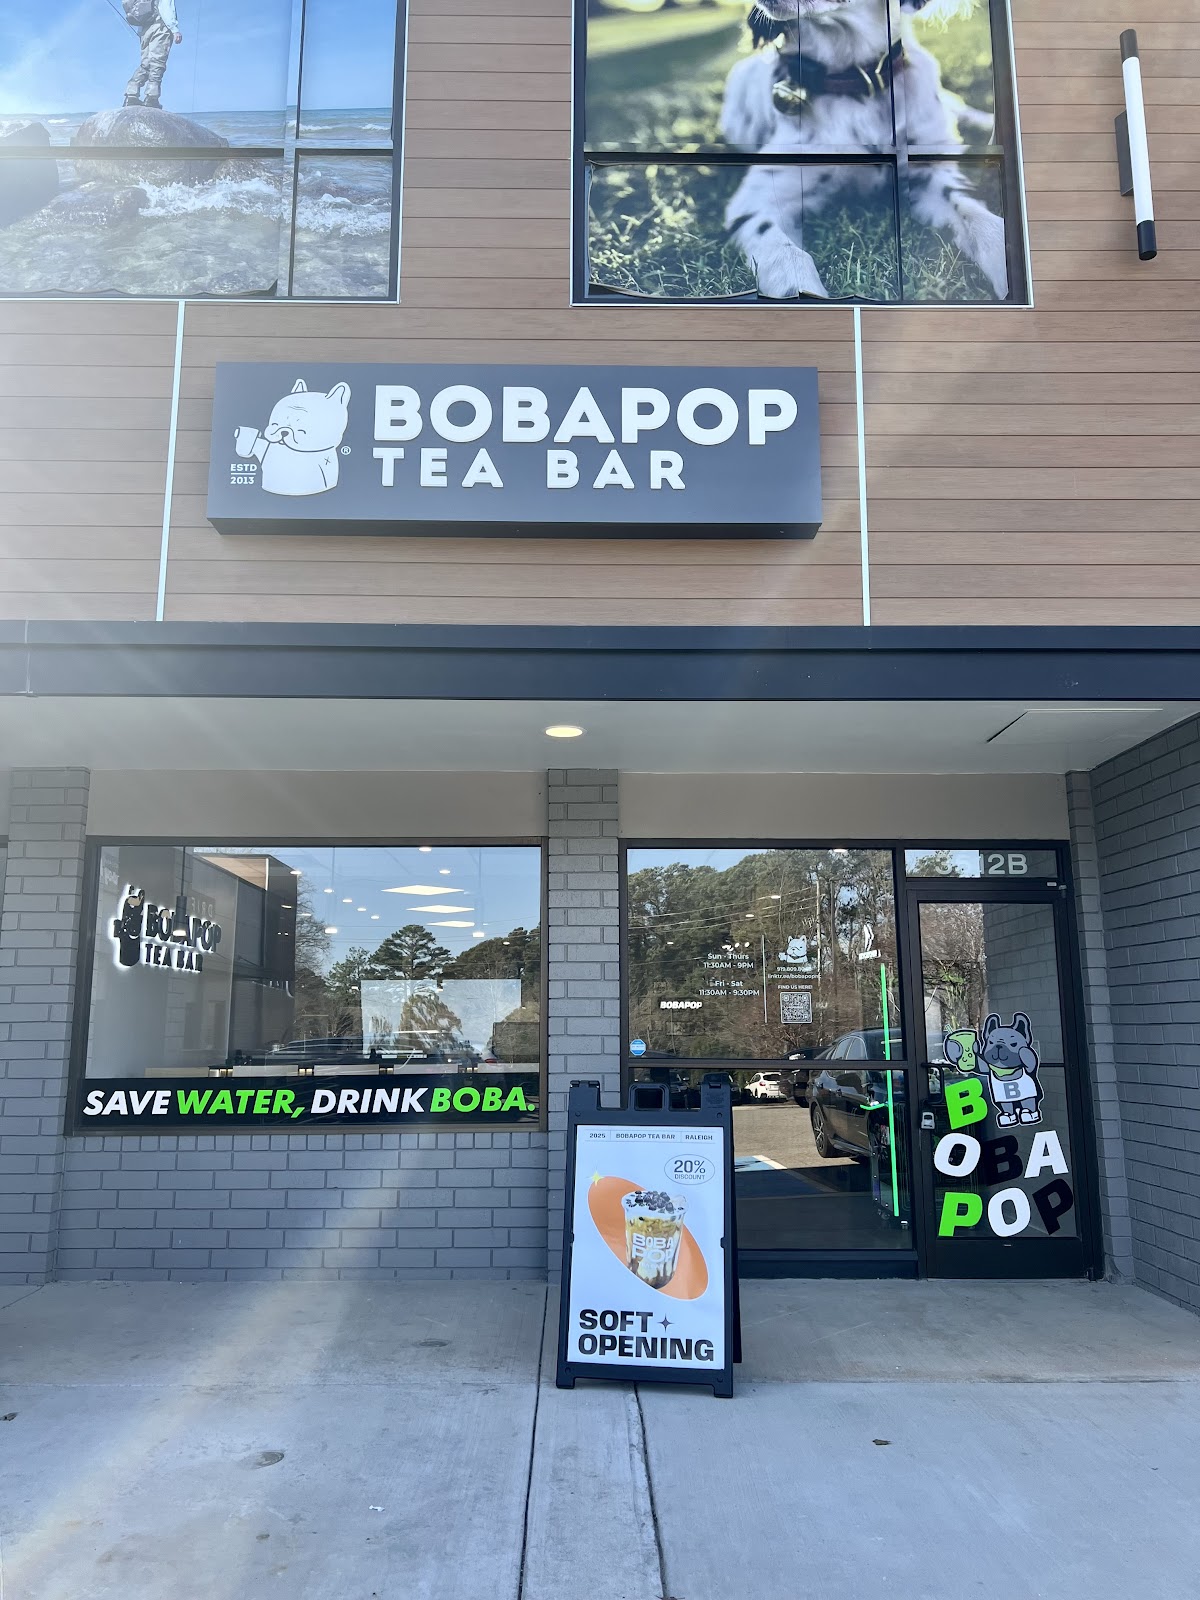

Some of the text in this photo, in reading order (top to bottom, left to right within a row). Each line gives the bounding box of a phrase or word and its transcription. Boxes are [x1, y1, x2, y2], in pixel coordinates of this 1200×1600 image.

[373, 384, 798, 446] BOBAPOP
[230, 464, 258, 472] ESTD
[373, 447, 686, 490] TEA BAR
[230, 476, 254, 484] 2013
[145, 943, 204, 972] TEA BAR
[660, 1001, 702, 1009] BOBAPOP
[82, 1086, 536, 1119] SAVE WATER, DRINK BOBA.
[674, 1160, 706, 1174] 20%
[632, 1232, 674, 1249] BOBA
[631, 1246, 675, 1263] POP
[579, 1308, 653, 1332] SOFT
[578, 1334, 714, 1361] OPENING
